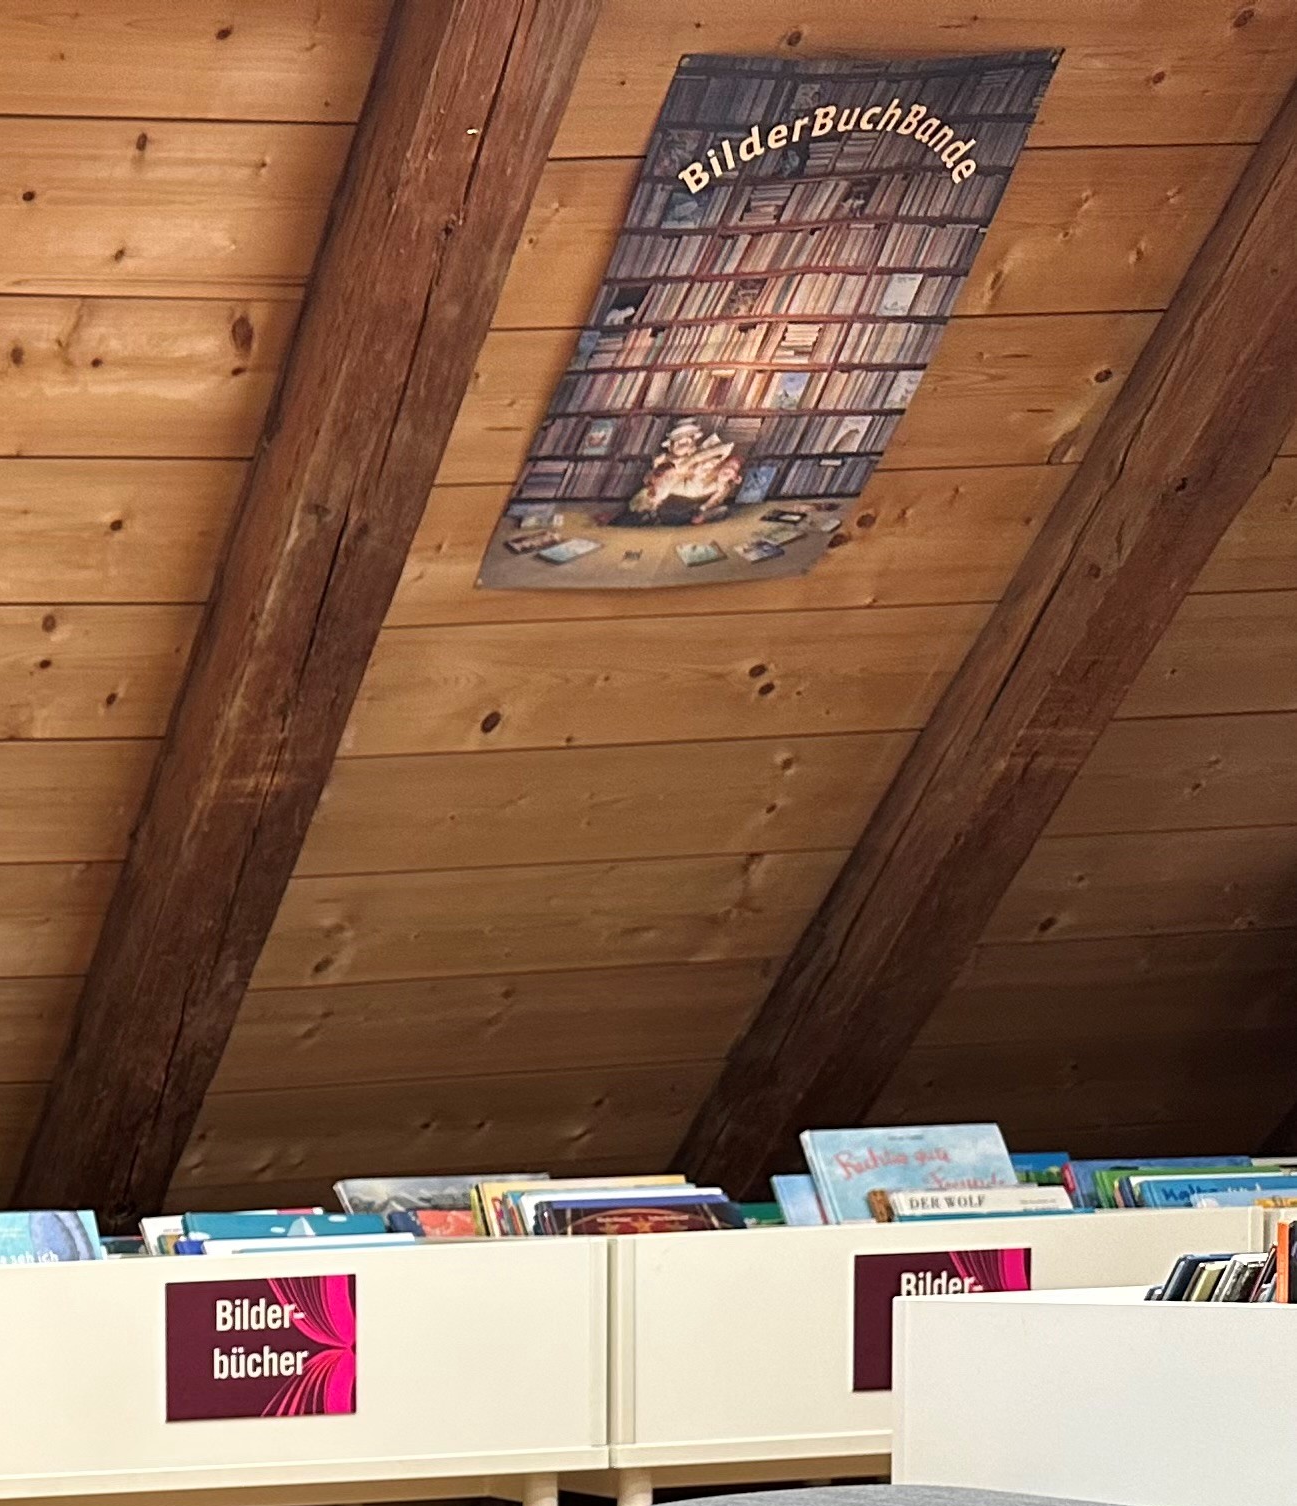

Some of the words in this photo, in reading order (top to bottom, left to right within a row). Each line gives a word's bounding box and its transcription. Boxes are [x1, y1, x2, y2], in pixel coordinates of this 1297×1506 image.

[678, 98, 978, 194] BilderBuchBande
[909, 1194, 940, 1210] DER
[944, 1193, 987, 1209] WOLF
[899, 1269, 984, 1295] Bilder-
[214, 1299, 305, 1332] Bilder-
[212, 1345, 309, 1380] bücher
